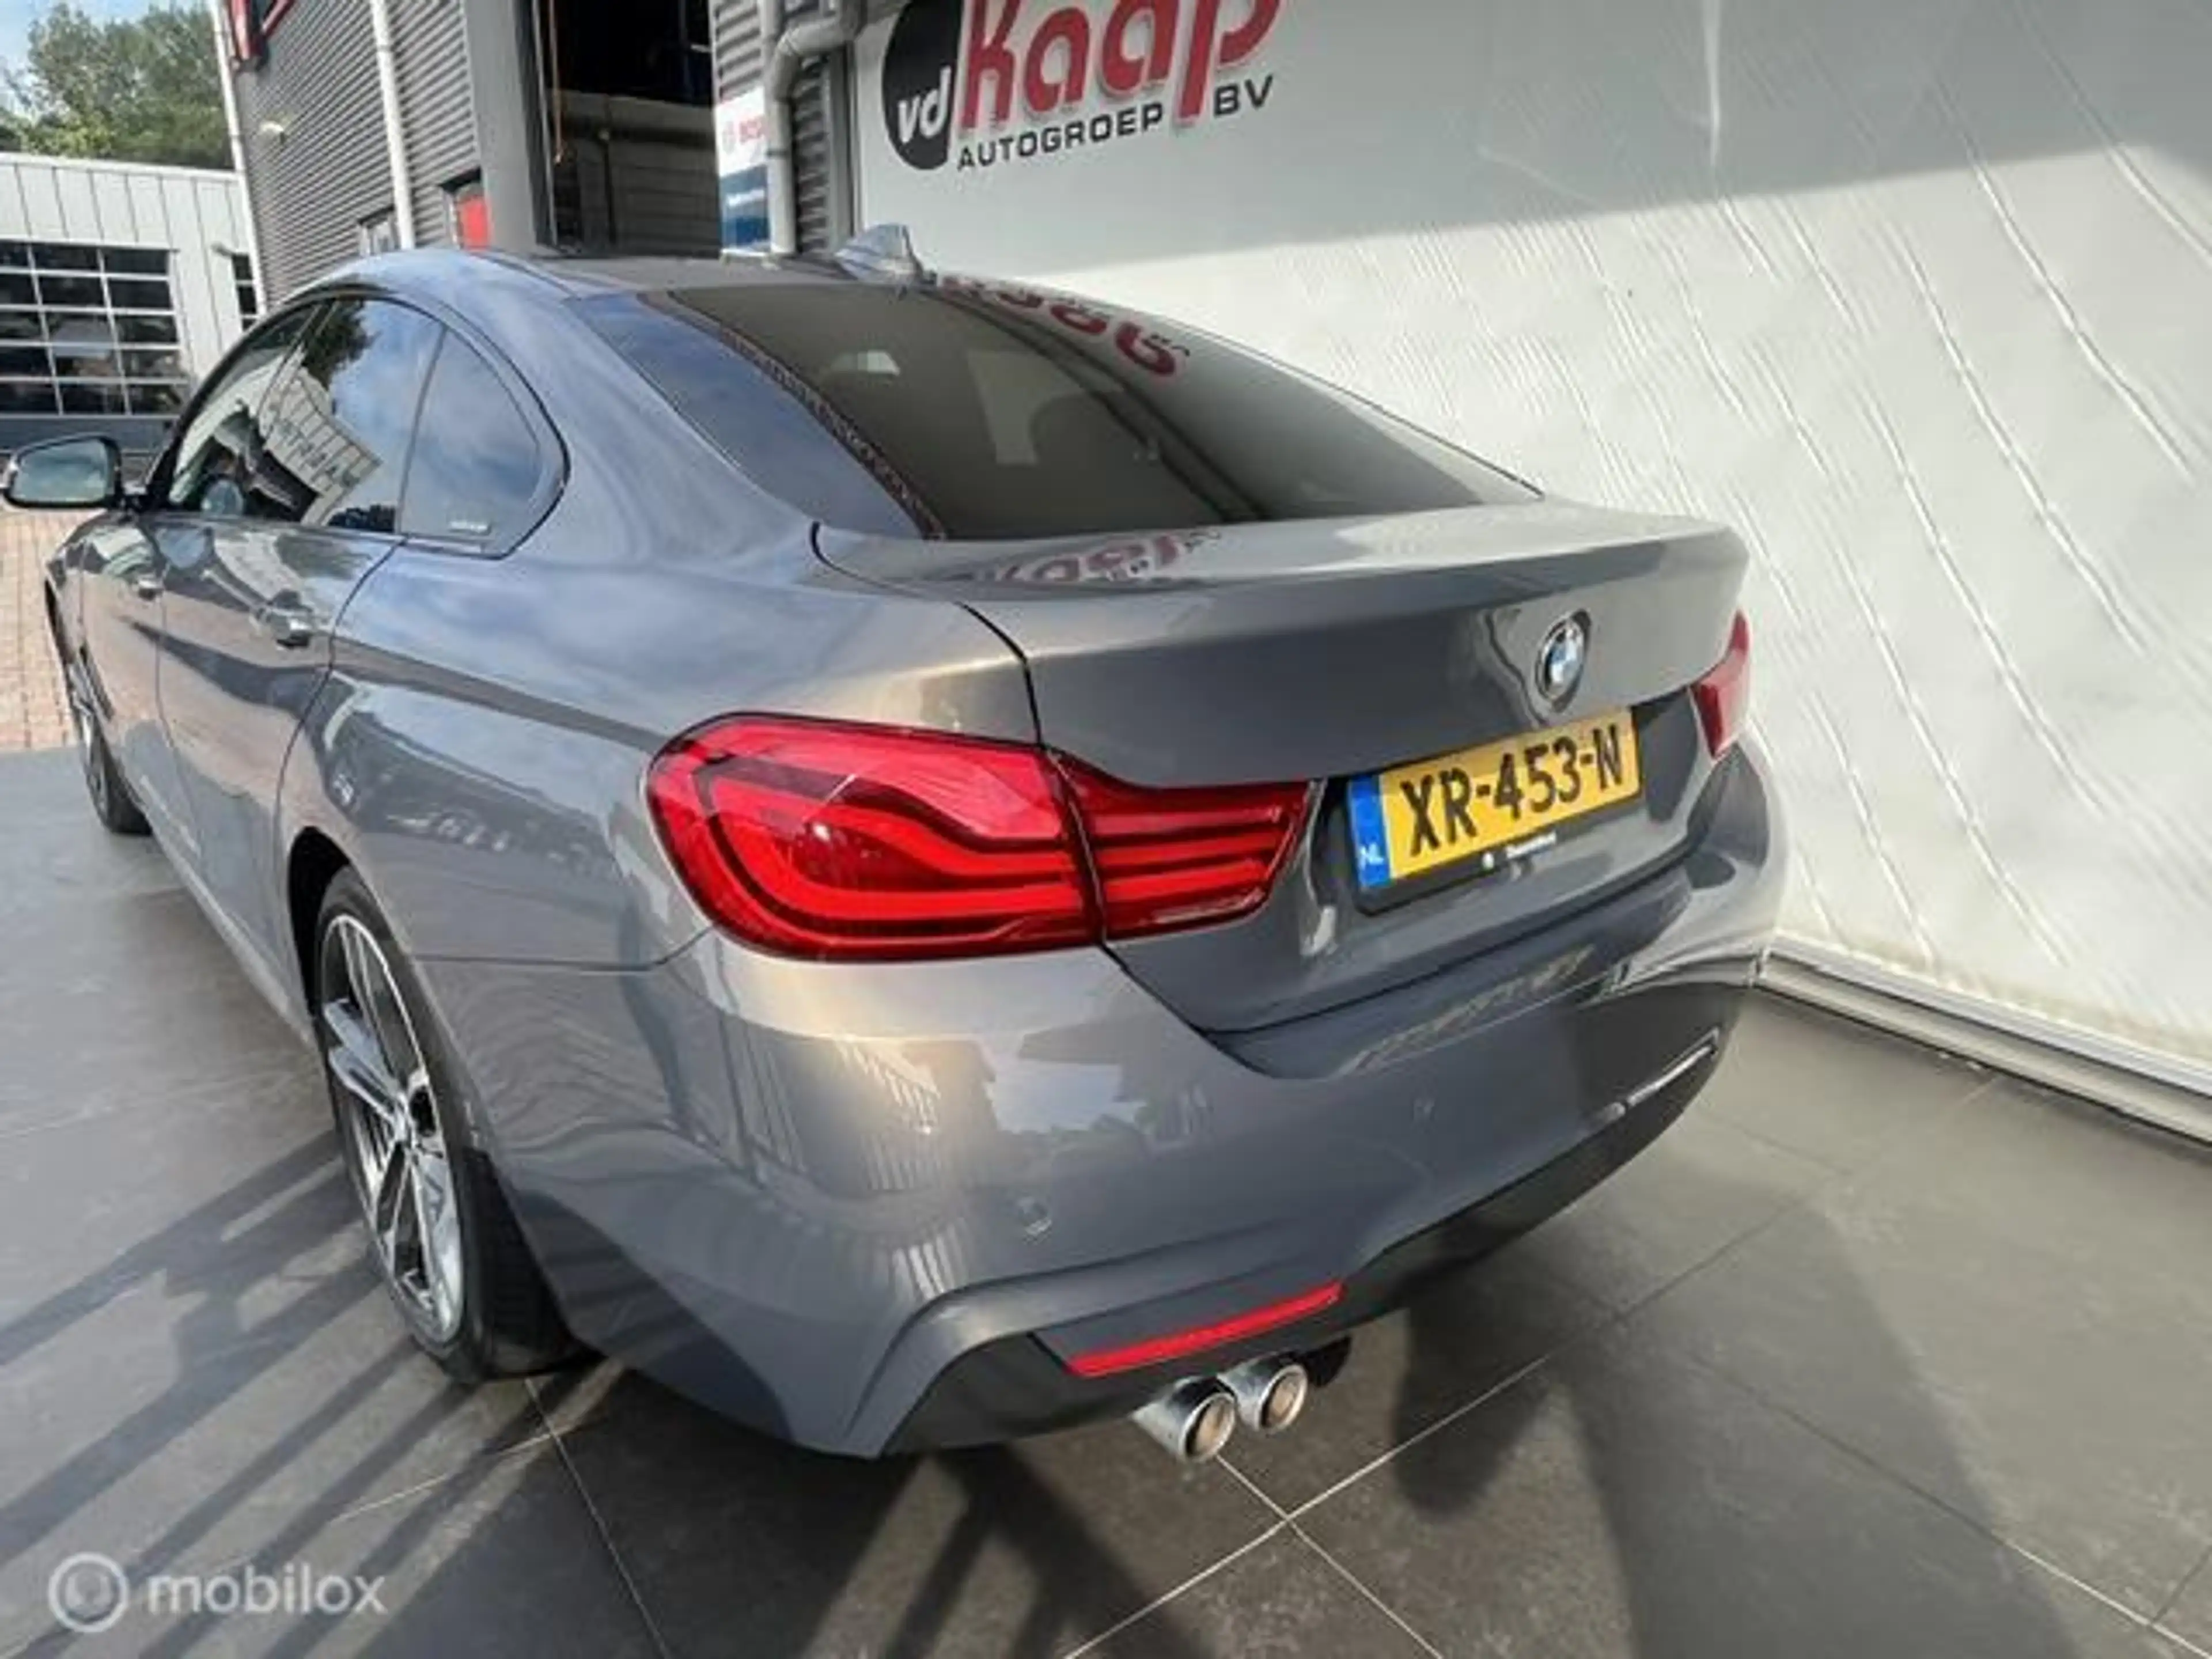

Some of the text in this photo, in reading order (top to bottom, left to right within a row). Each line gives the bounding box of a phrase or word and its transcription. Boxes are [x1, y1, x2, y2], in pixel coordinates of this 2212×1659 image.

[897, 66, 952, 144] vd
[957, 75, 1274, 172] AUTOGROEP BV
[1401, 724, 1623, 857] XR-453-N
